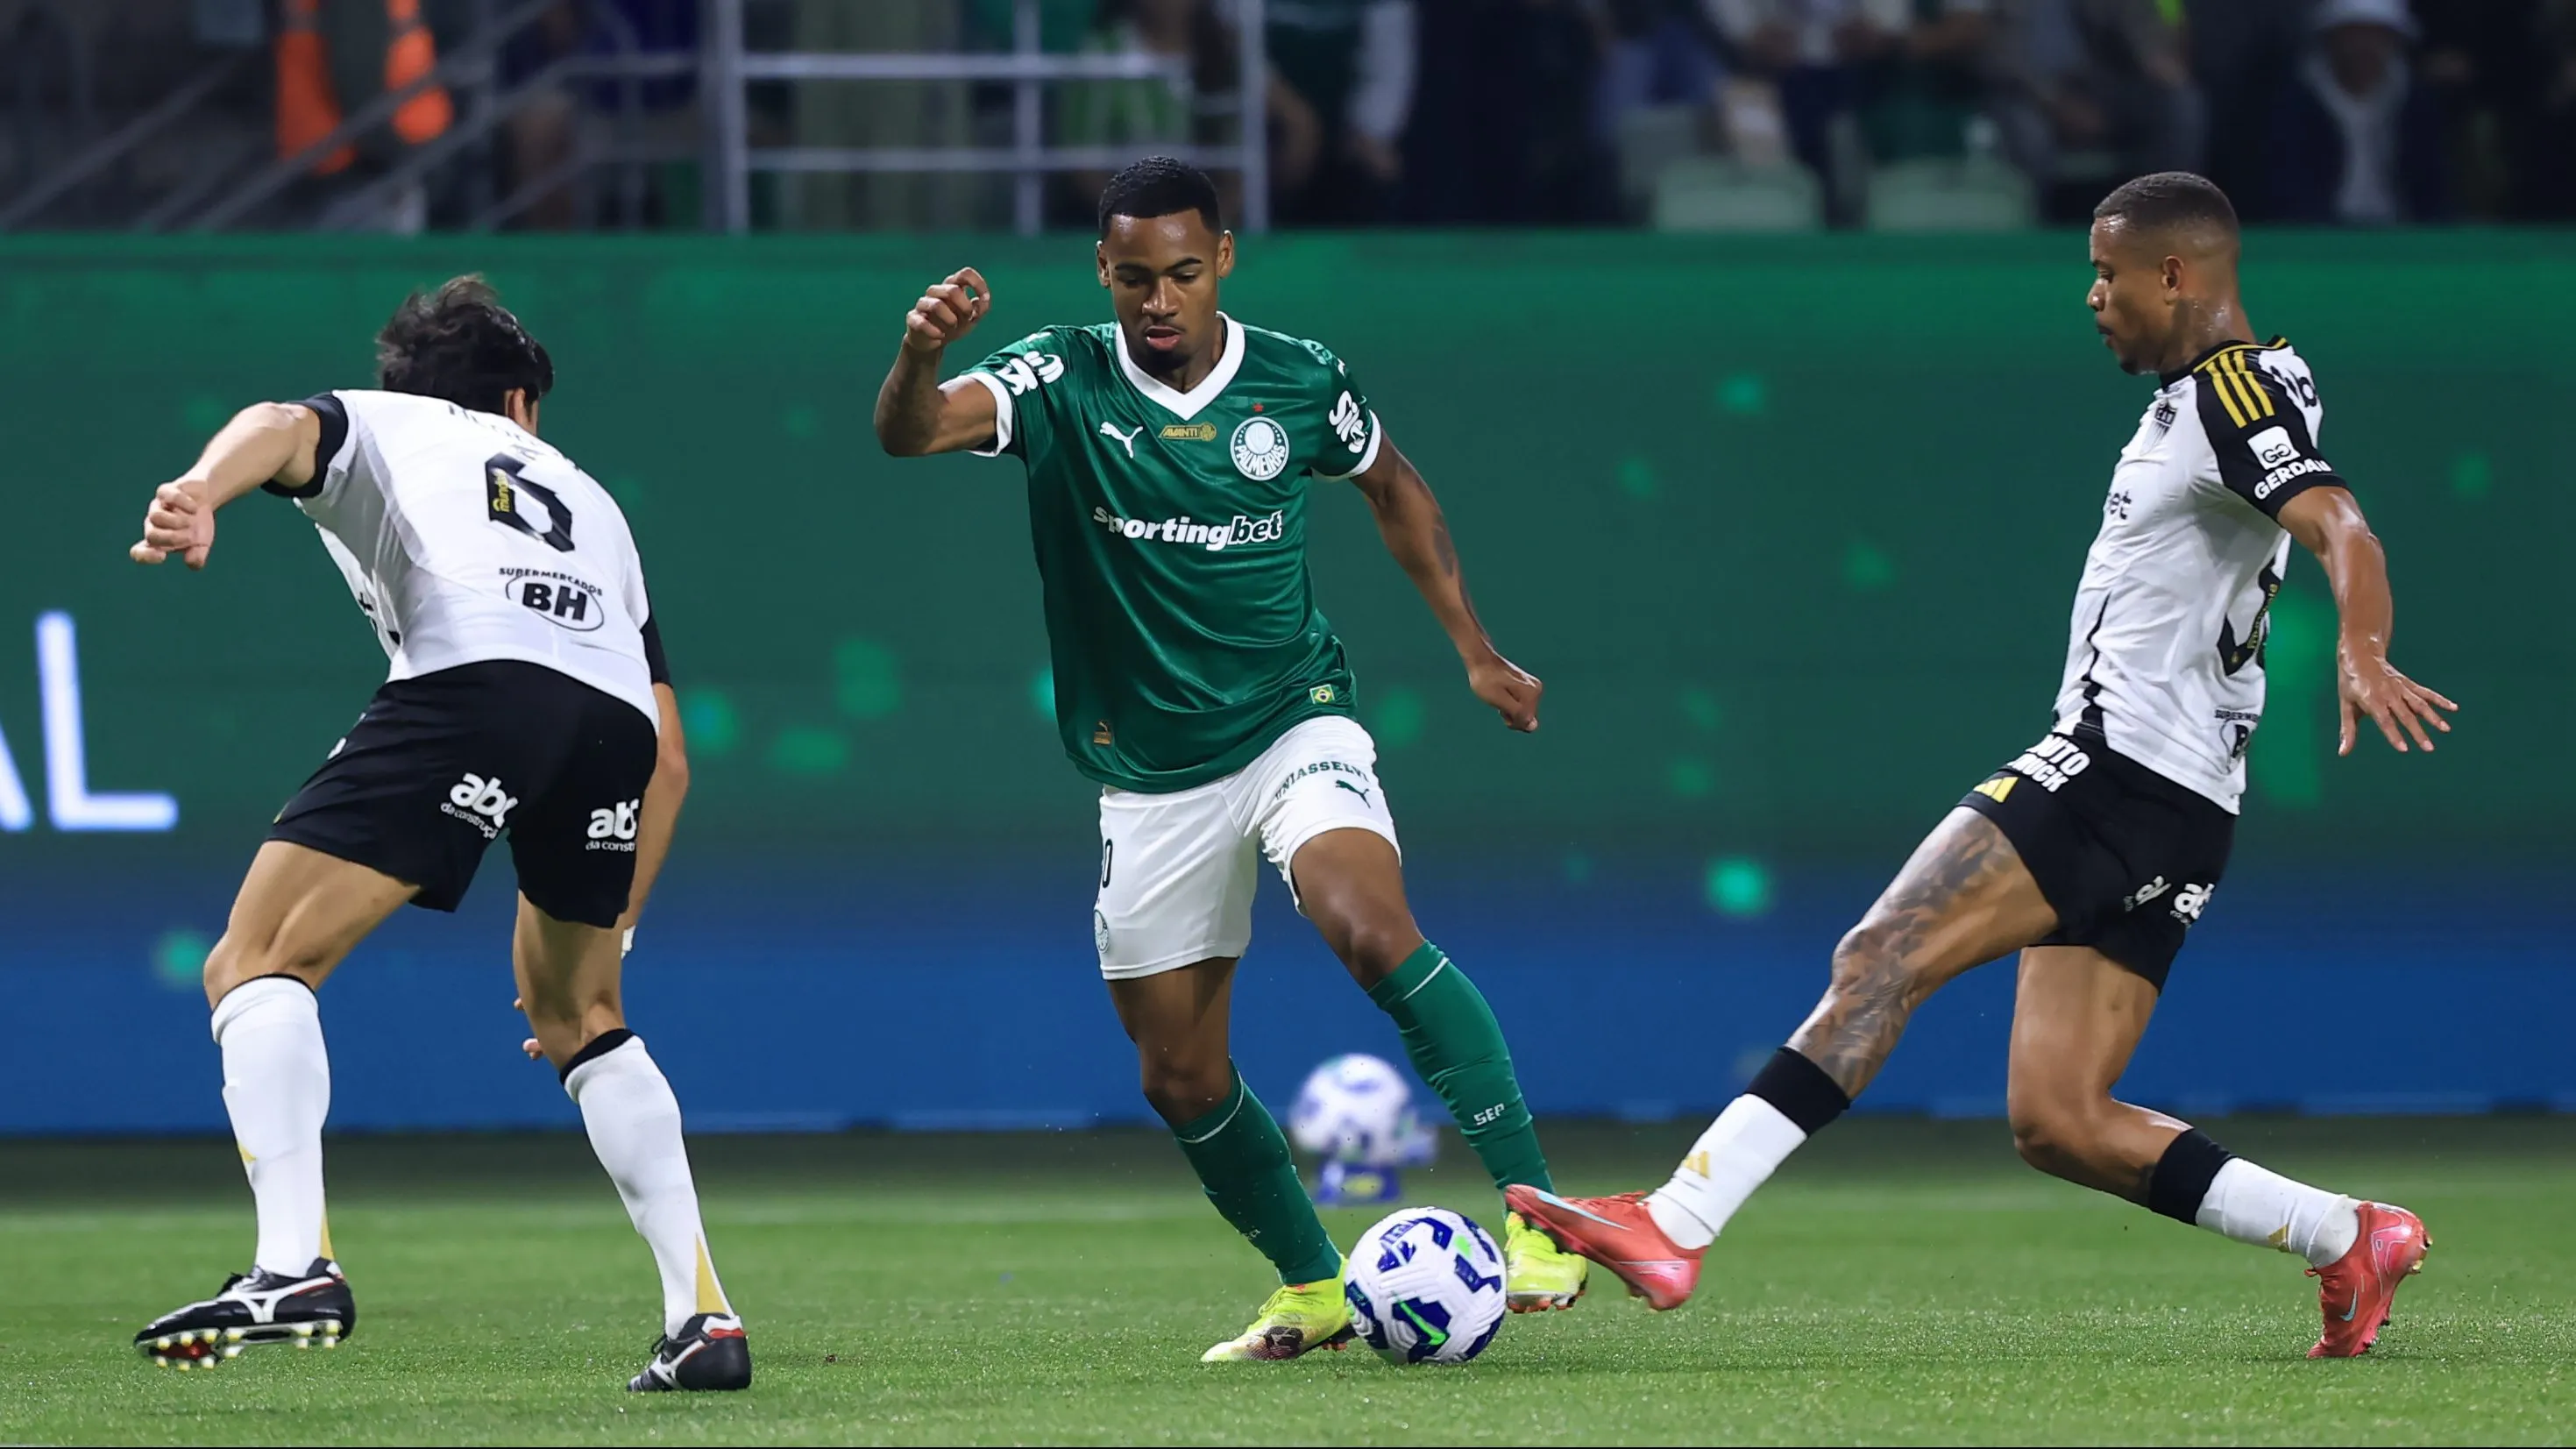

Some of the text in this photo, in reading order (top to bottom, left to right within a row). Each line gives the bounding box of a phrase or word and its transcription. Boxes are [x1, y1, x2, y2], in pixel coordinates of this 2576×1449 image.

[1162, 426, 1198, 437] AVANTI
[1234, 444, 1286, 476] PALMEIRAS
[2253, 458, 2332, 501] GERDAU
[485, 452, 575, 552] 6
[1094, 506, 1284, 551] sportingbet
[499, 567, 603, 596] SUPERMERCADOS
[522, 582, 587, 622] BH
[1473, 1103, 1505, 1126] SEP
